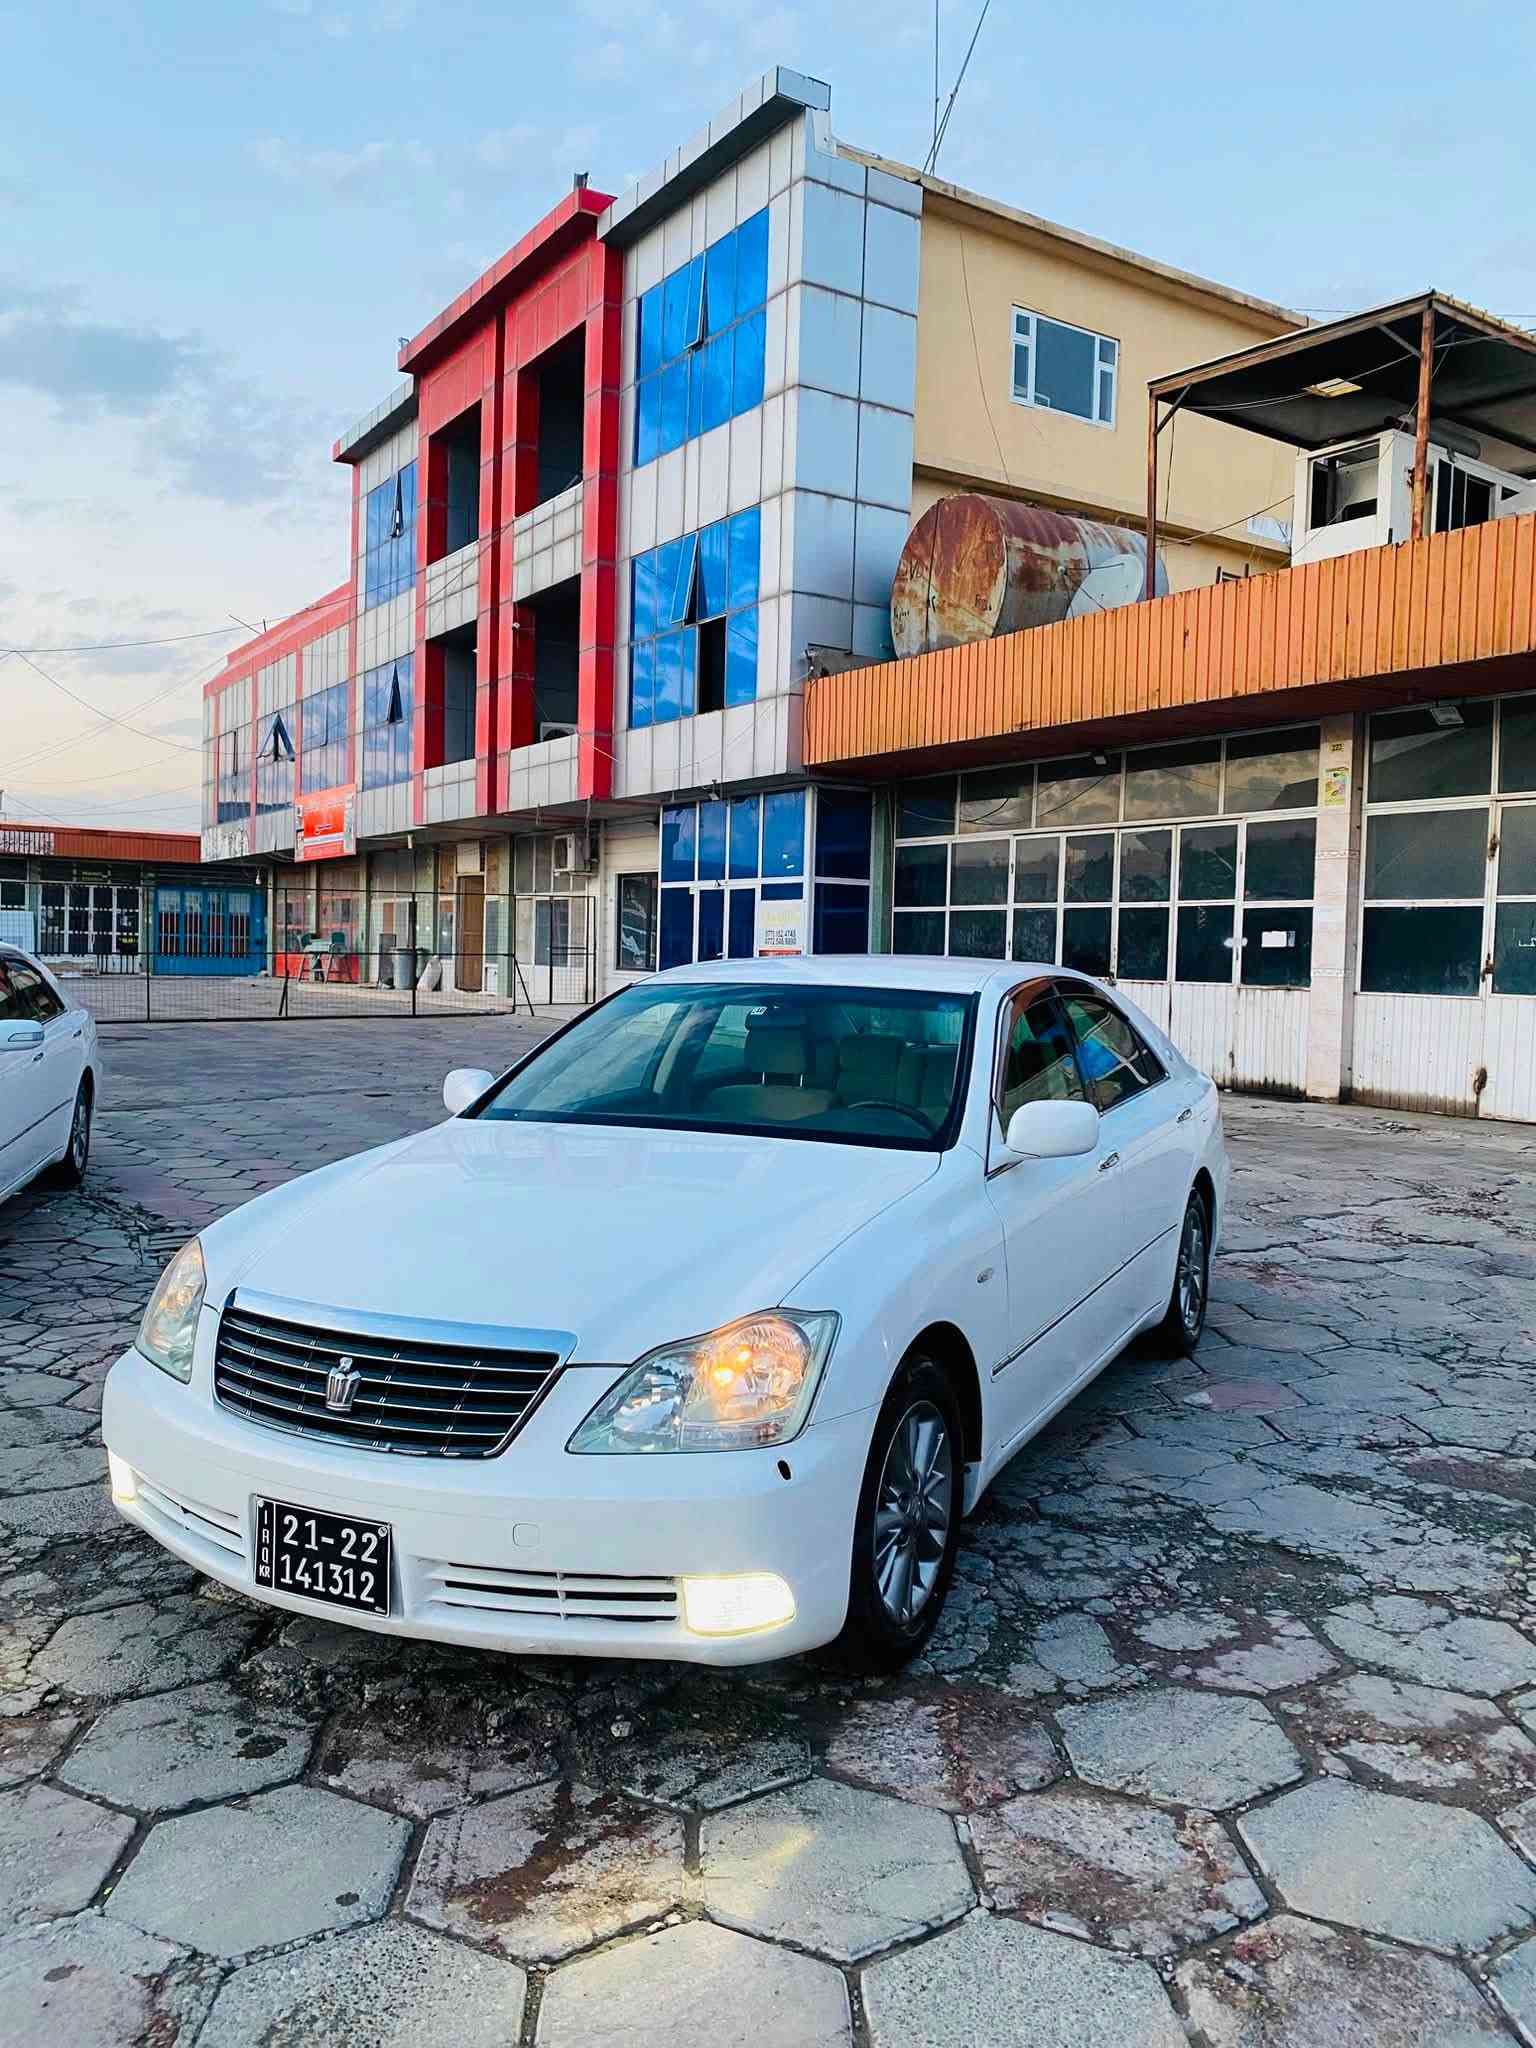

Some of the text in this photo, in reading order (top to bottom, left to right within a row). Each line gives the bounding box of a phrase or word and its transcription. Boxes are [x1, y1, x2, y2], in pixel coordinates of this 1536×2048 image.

[283, 1514, 378, 1565] 21-22
[259, 1564, 271, 1578] KR
[280, 1553, 375, 1604] 141312
